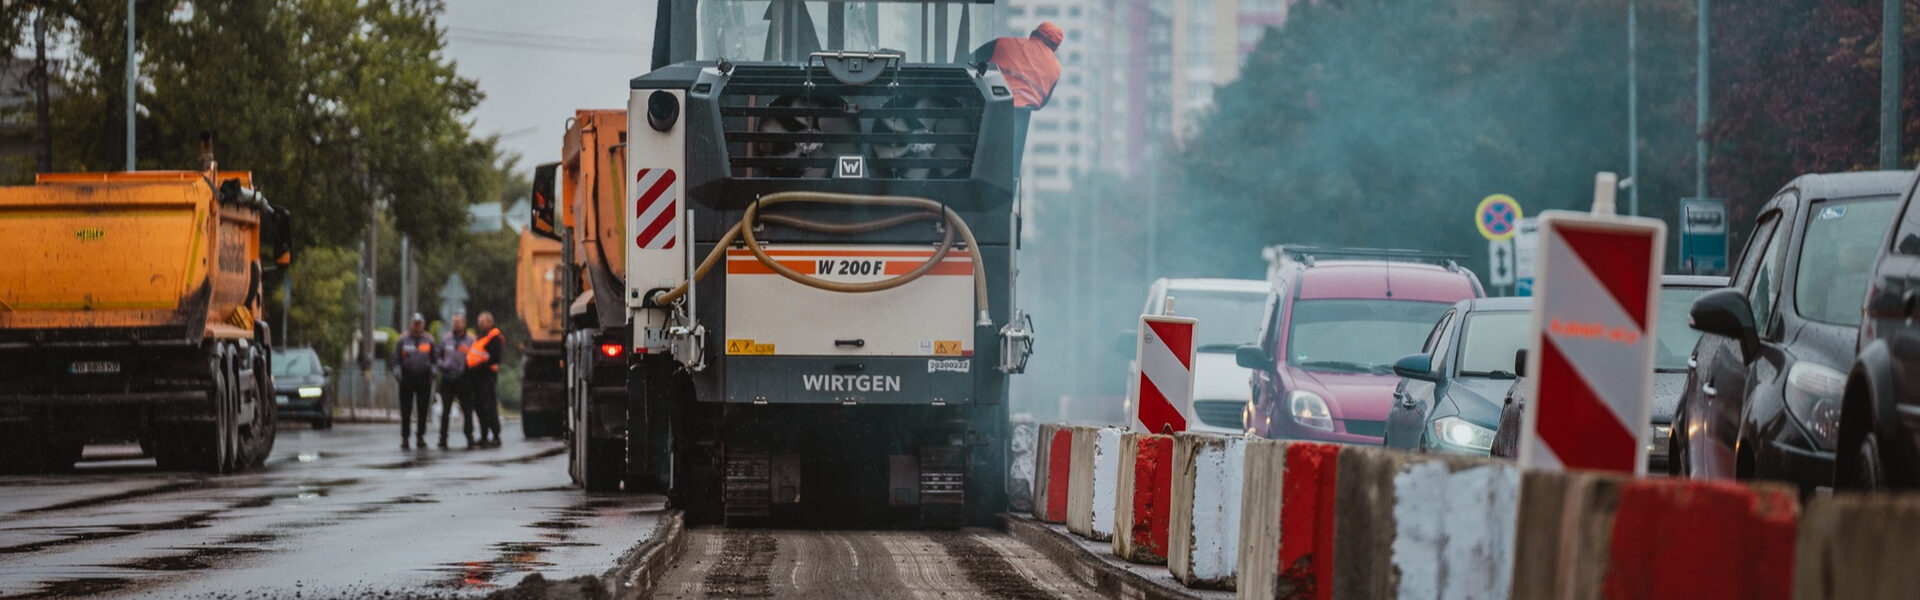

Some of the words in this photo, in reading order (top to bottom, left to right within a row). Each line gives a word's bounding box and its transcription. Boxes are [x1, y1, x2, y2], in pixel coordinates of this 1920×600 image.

[819, 260, 835, 275] W
[838, 260, 871, 275] 200
[873, 260, 883, 275] F
[803, 374, 900, 392] WIRTGEN
